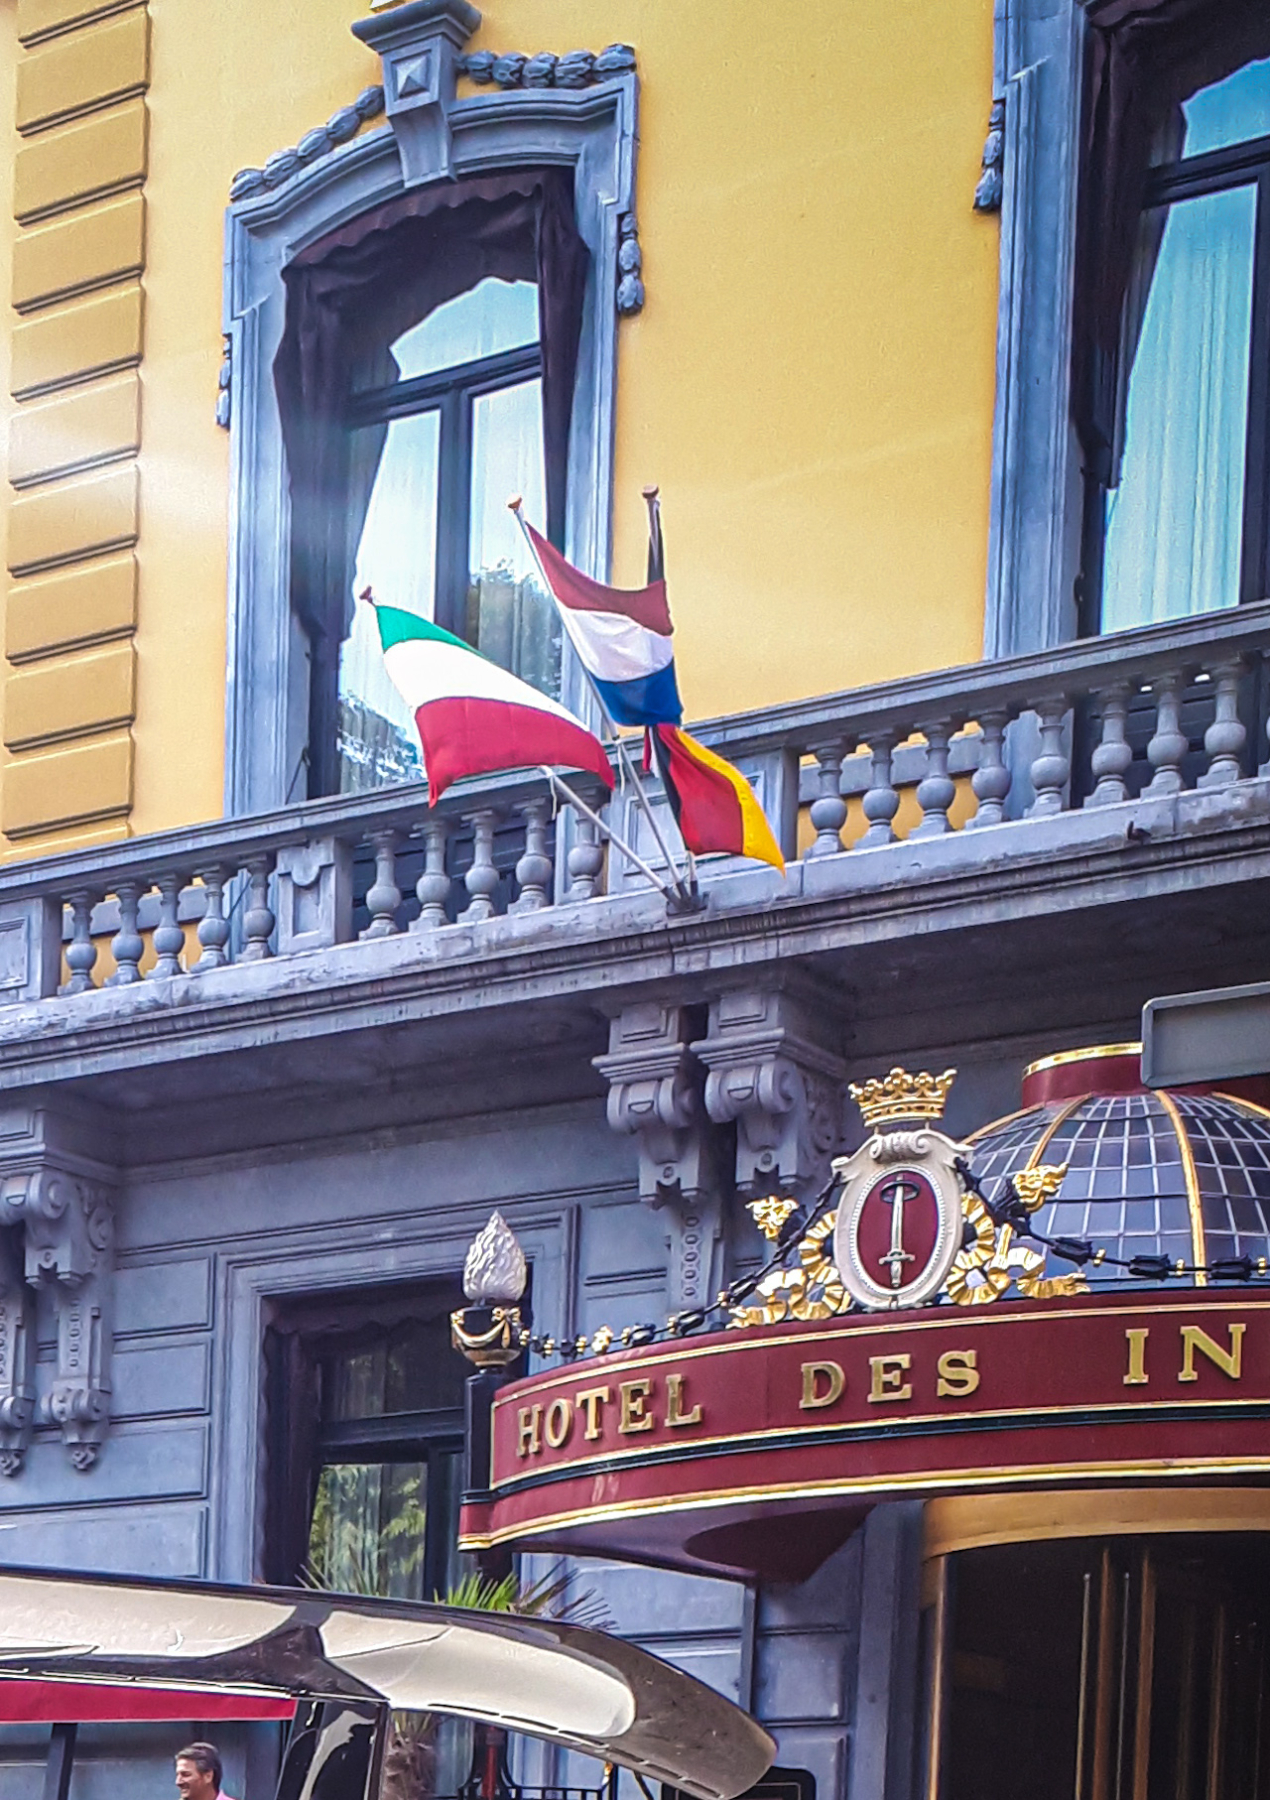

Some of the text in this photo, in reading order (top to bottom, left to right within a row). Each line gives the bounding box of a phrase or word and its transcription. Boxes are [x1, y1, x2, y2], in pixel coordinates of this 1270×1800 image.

[516, 1323, 1247, 1456] HOTEL DES IN
